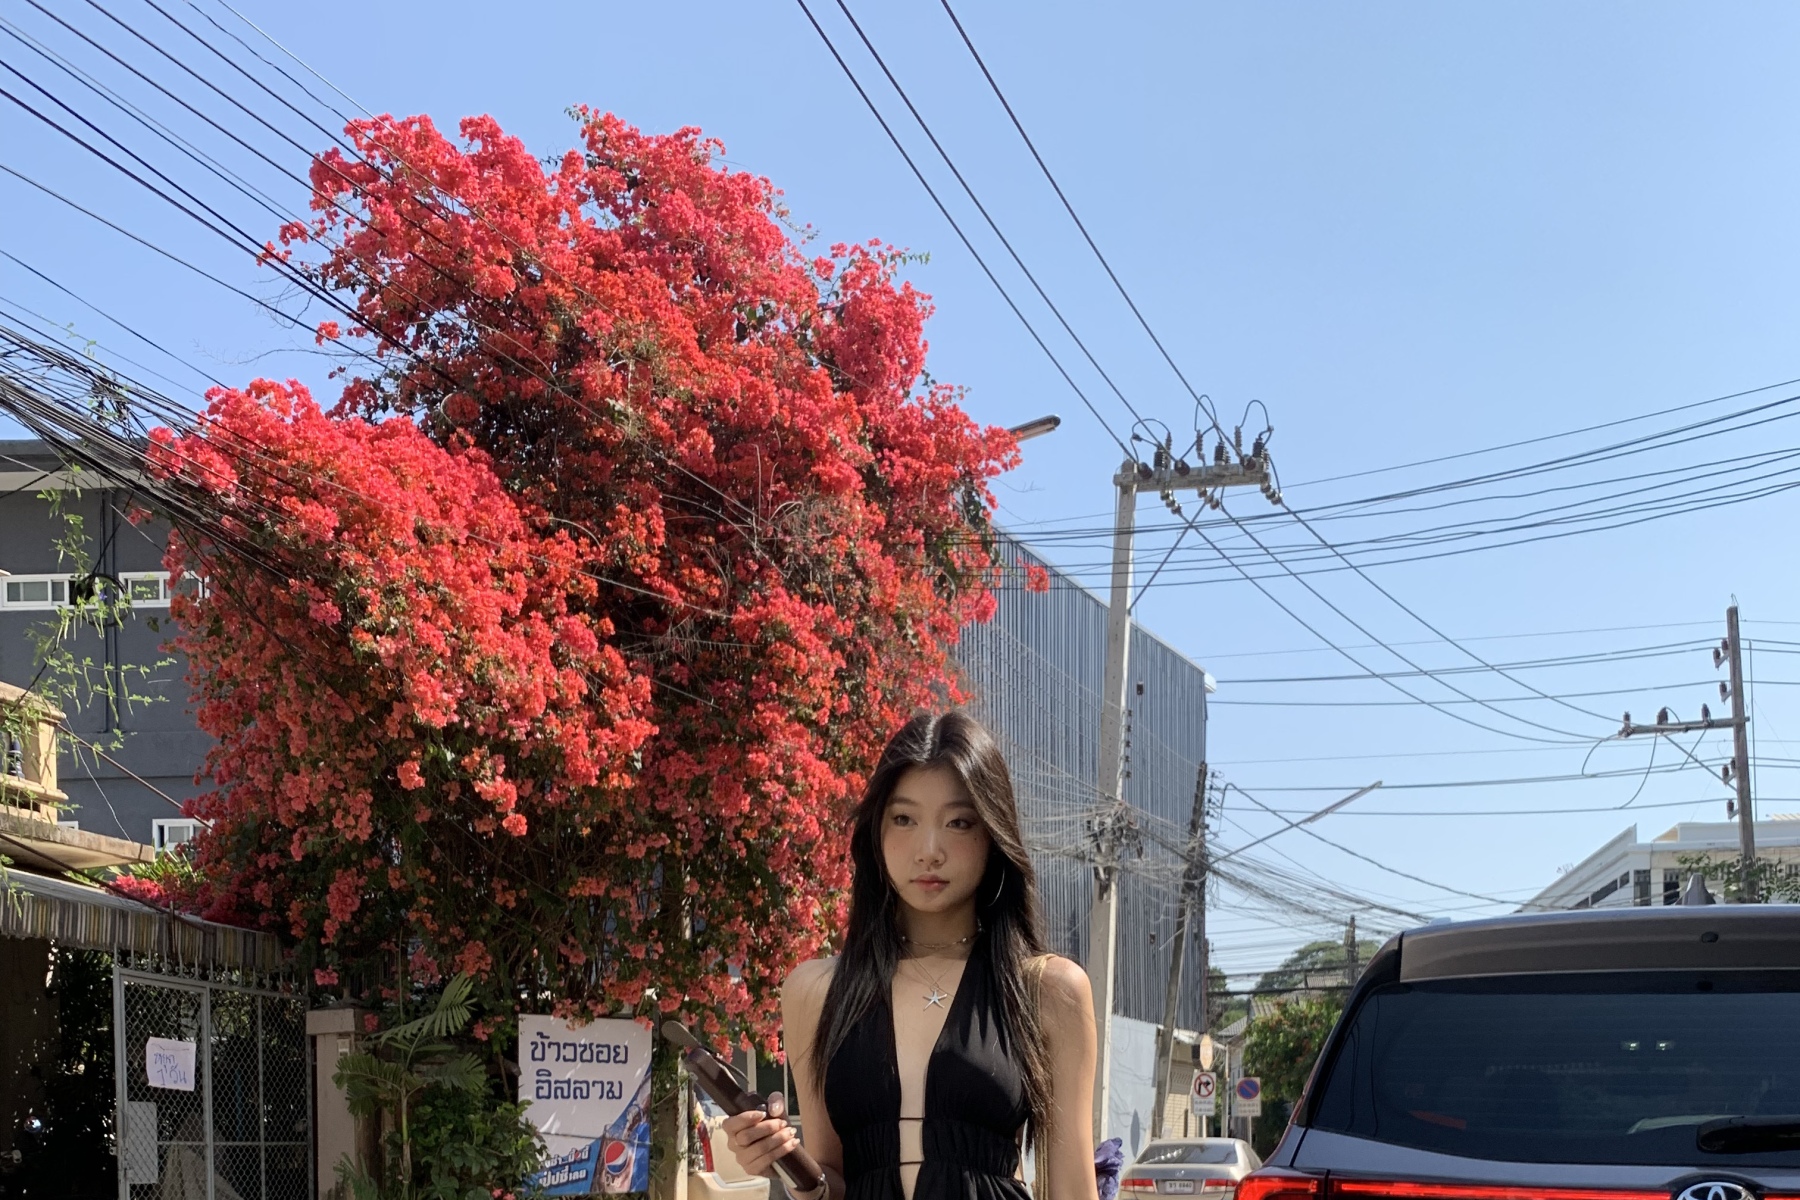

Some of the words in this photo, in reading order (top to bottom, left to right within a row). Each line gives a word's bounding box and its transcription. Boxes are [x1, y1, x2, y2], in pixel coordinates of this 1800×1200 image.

[530, 1031, 629, 1064] ข้าวซอย
[535, 1068, 623, 1100] อิสลาม
